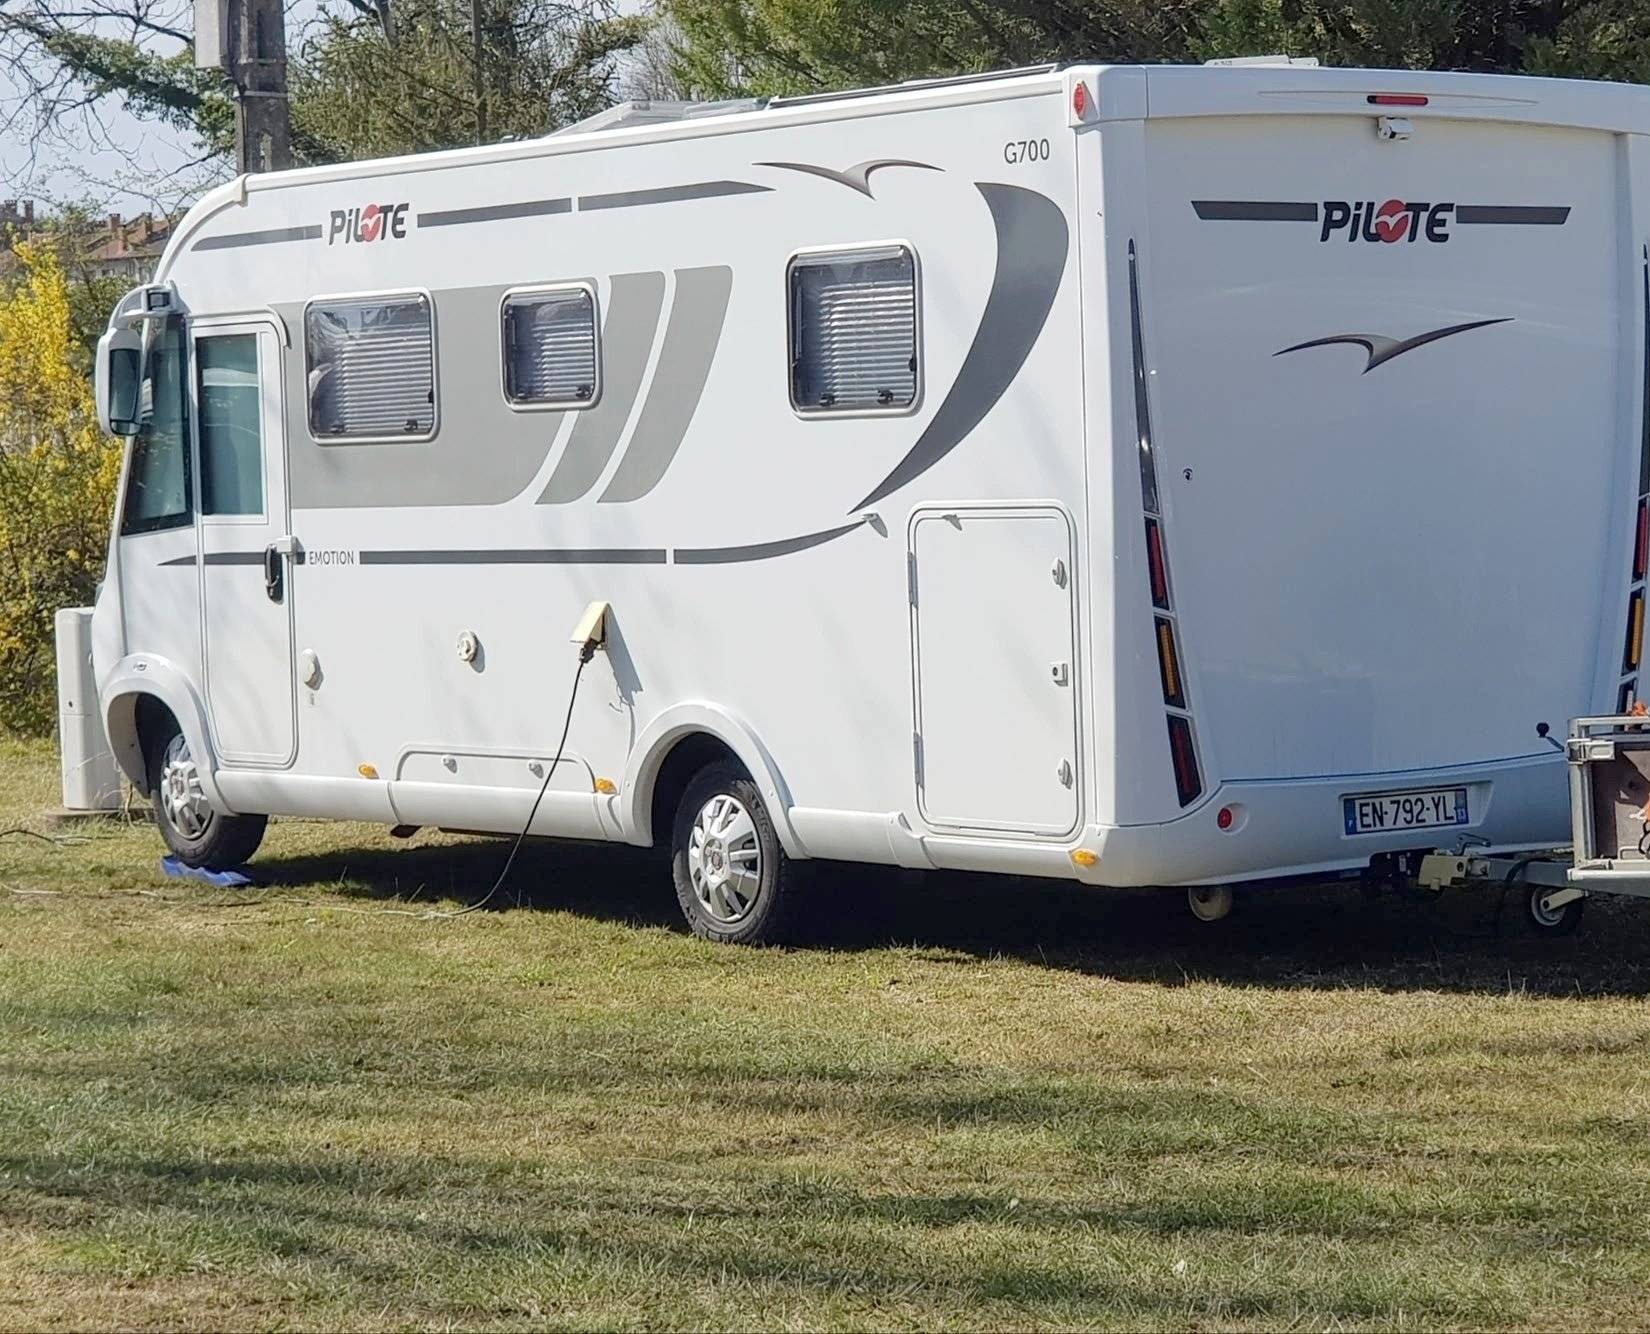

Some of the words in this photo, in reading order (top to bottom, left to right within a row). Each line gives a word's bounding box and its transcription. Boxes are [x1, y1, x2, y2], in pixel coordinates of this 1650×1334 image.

[1004, 138, 1050, 164] G700
[309, 550, 354, 565] EMOTION
[1359, 796, 1454, 828] EN-792-YL
